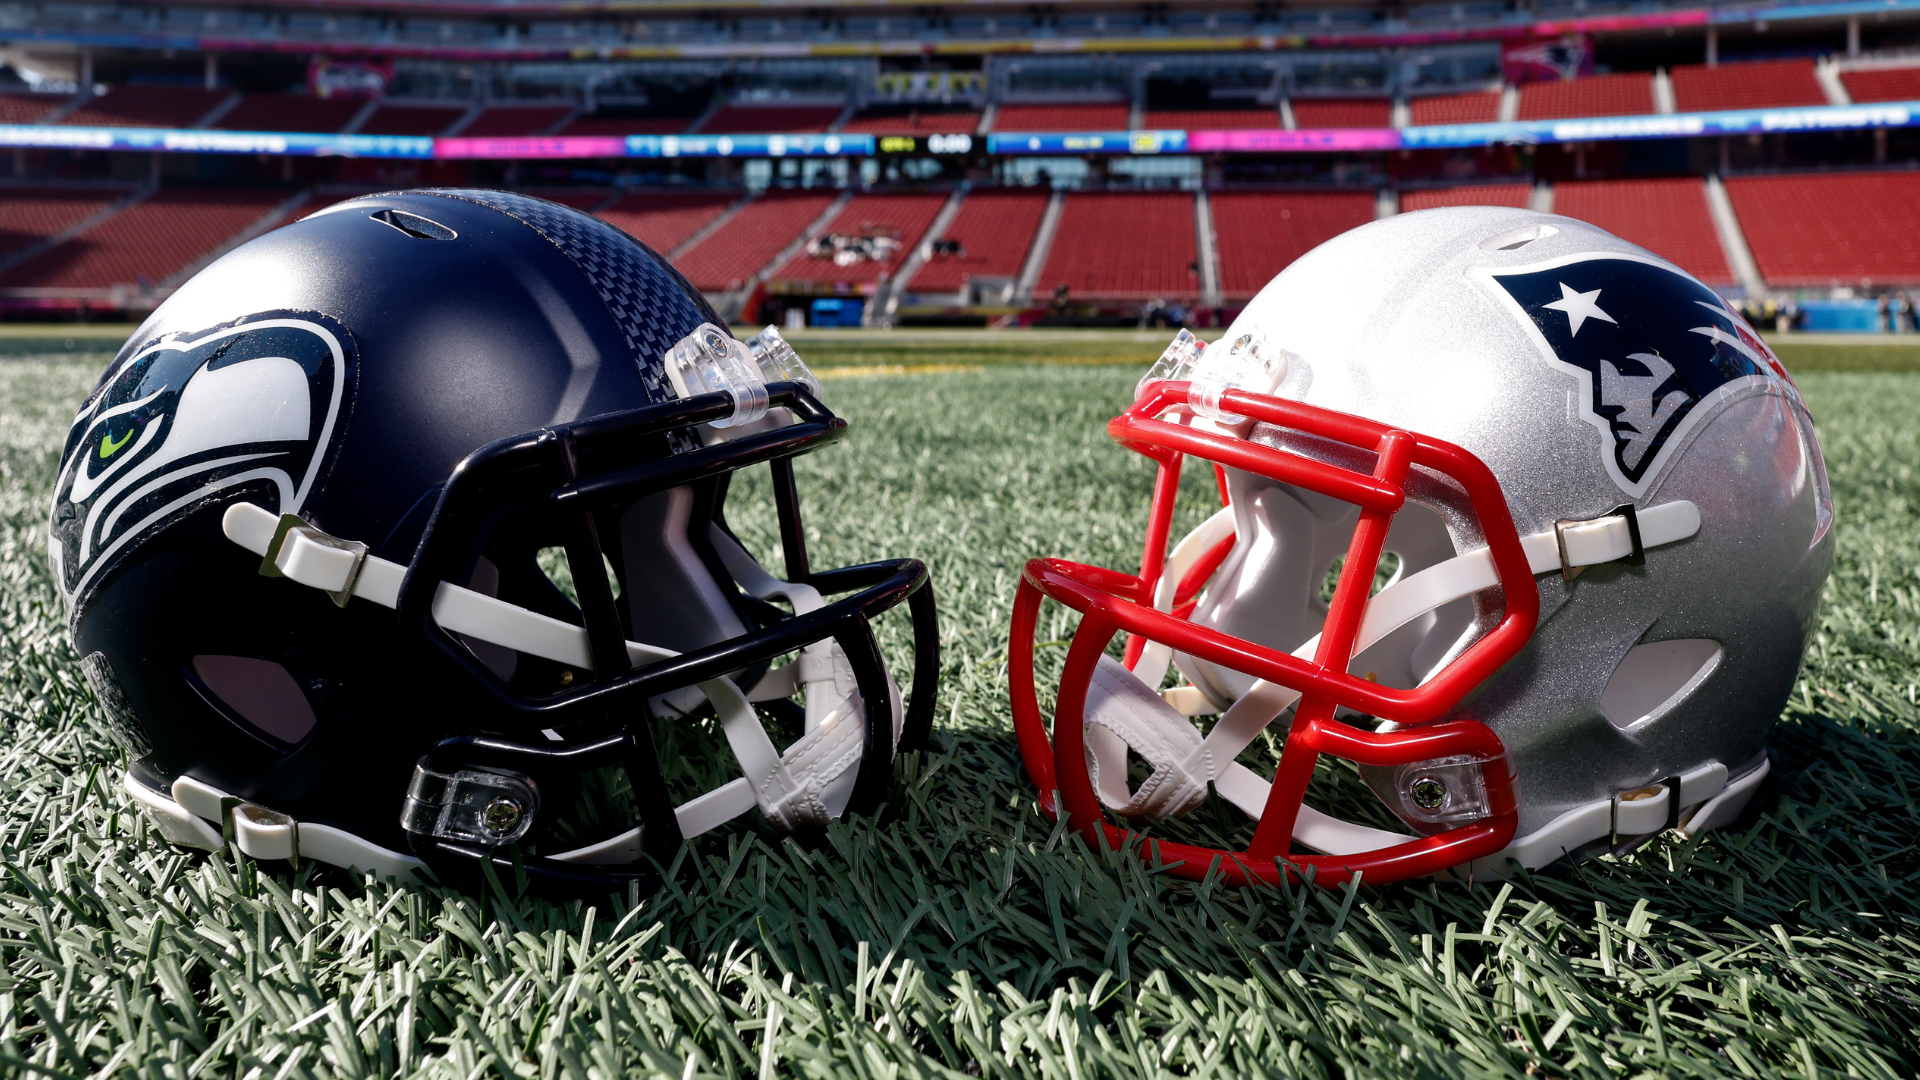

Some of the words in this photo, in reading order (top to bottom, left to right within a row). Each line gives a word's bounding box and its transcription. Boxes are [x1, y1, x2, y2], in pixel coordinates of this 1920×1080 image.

[1553, 116, 1704, 139] SEAHAWKS
[1762, 107, 1910, 131] PATRIOTS
[165, 133, 287, 152] PATRIOTS
[928, 133, 972, 154] 0:00
